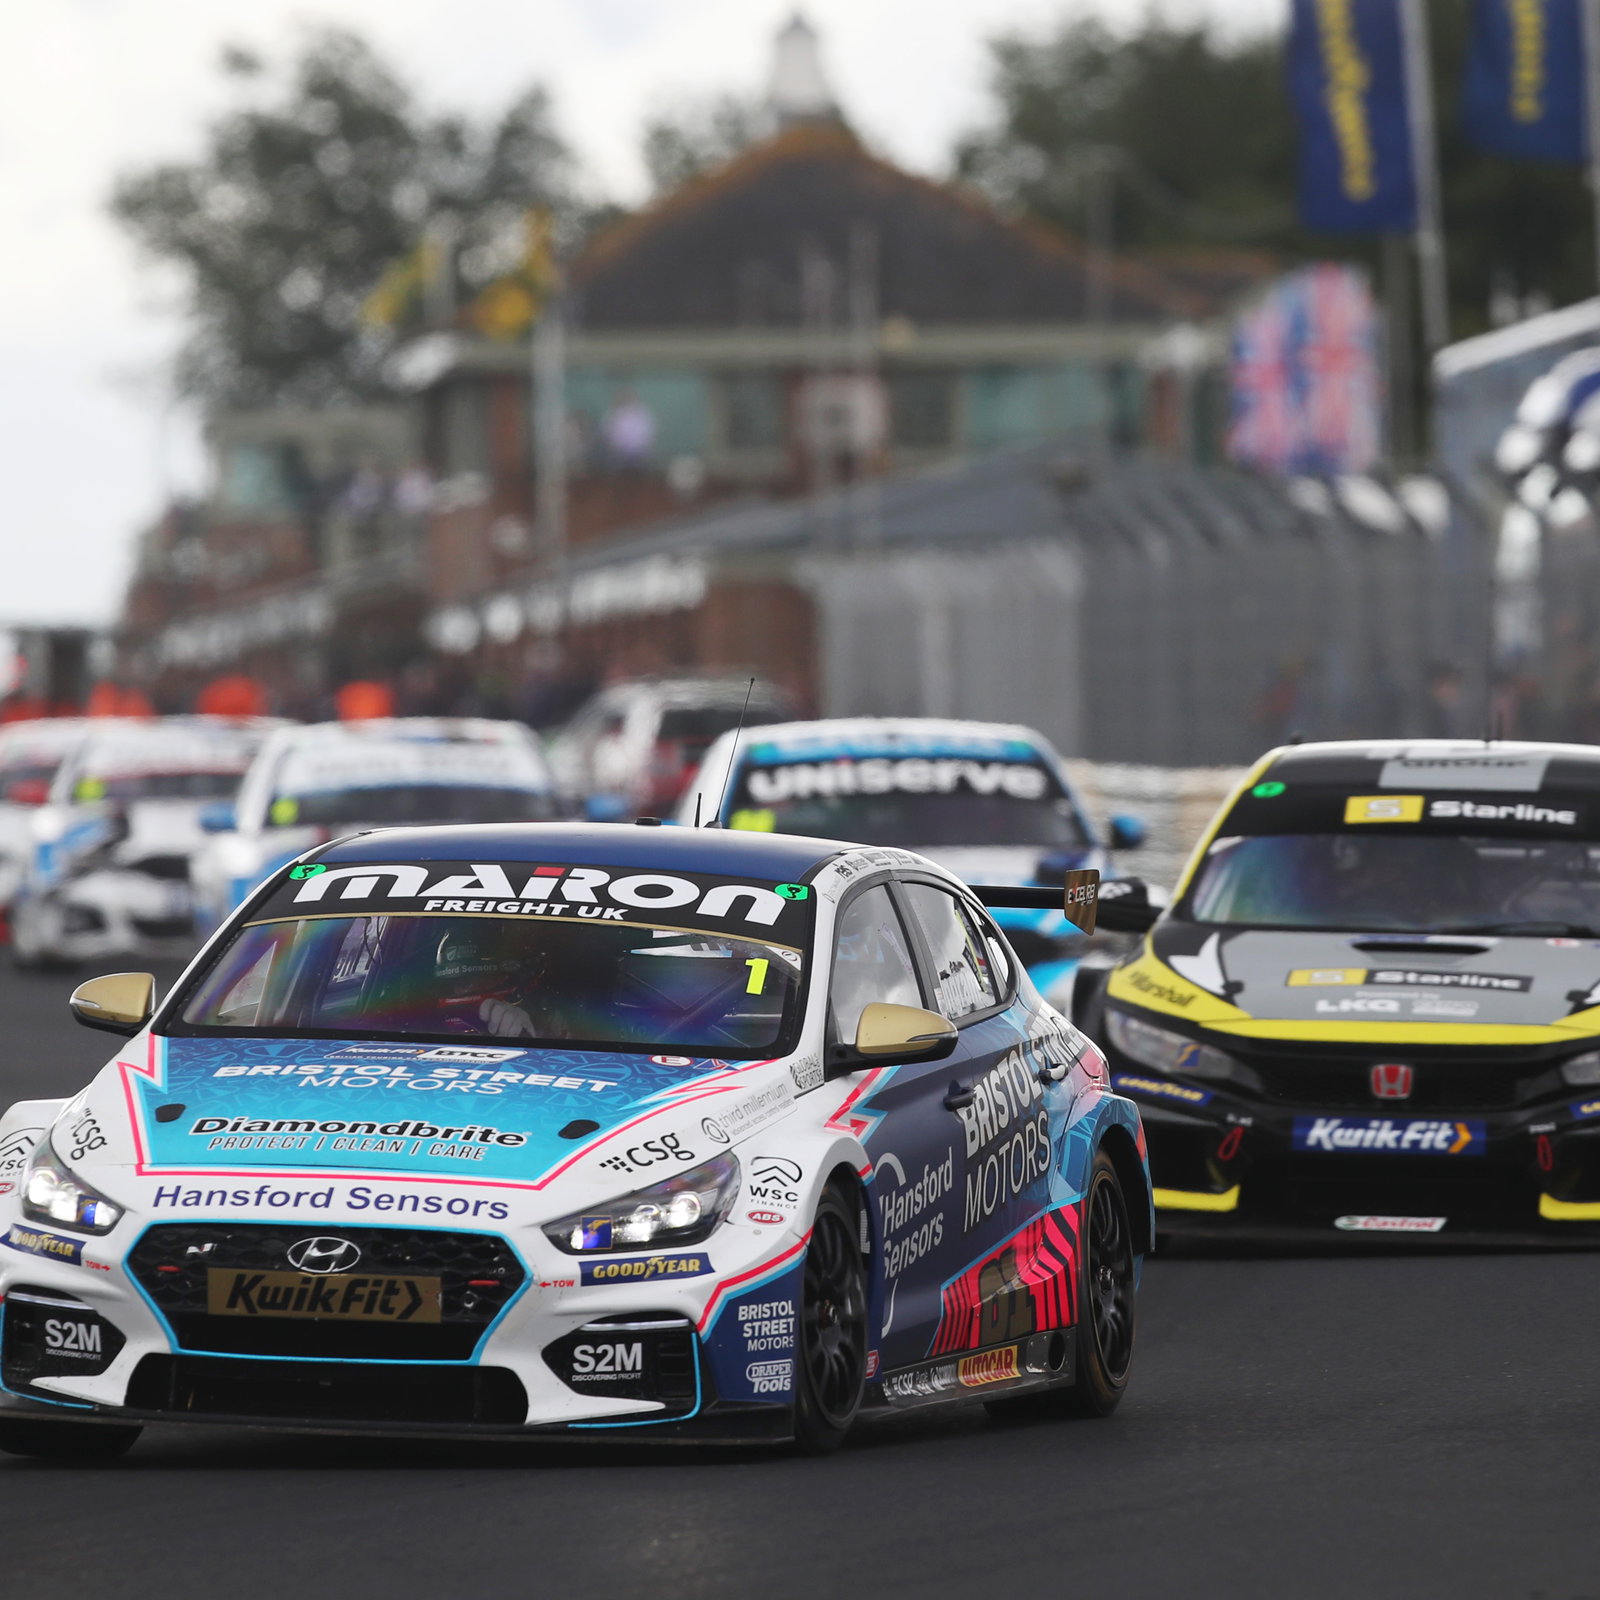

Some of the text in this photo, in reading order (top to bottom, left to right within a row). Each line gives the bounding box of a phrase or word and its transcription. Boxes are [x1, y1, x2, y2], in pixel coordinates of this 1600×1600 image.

[1430, 801, 1577, 825] Starline
[424, 899, 629, 921] FREIGHT UK
[744, 958, 769, 996] 1
[1374, 970, 1523, 990] Starline
[1315, 999, 1401, 1014] LKQ
[434, 1049, 507, 1060] BTCC
[212, 1065, 618, 1092] BRISTOL STREET
[299, 1075, 507, 1095] MOTORS
[719, 1107, 744, 1129] third
[743, 1082, 789, 1115] millennium
[957, 1041, 1043, 1159] BRISTOL
[191, 1116, 527, 1148] Diamondbrite
[1306, 1118, 1451, 1150] KwikFit
[206, 1135, 487, 1162] PROTECT CLEAN CARE
[626, 1131, 696, 1168] csg
[964, 1110, 1051, 1233] MOTORS
[152, 1184, 510, 1220] Hansford Sensors
[750, 1184, 800, 1203] WSC
[750, 1198, 799, 1210] FINANCE
[884, 1147, 954, 1239] Hansford
[751, 1211, 783, 1223] ABS
[85, 1261, 102, 1271] TOW
[226, 1272, 401, 1315] KwikFit
[552, 1279, 575, 1289] TOW
[738, 1300, 795, 1321] BRISTOL
[45, 1319, 102, 1353] S2M
[743, 1317, 795, 1338] STREET
[747, 1335, 795, 1352] MOTORS
[571, 1342, 643, 1373] S2M
[962, 1348, 1016, 1386] AUTOCAR
[571, 1372, 642, 1382] DISCOVERING PROFIT
[752, 1361, 792, 1379] DRAPER
[752, 1377, 791, 1394] Tools
